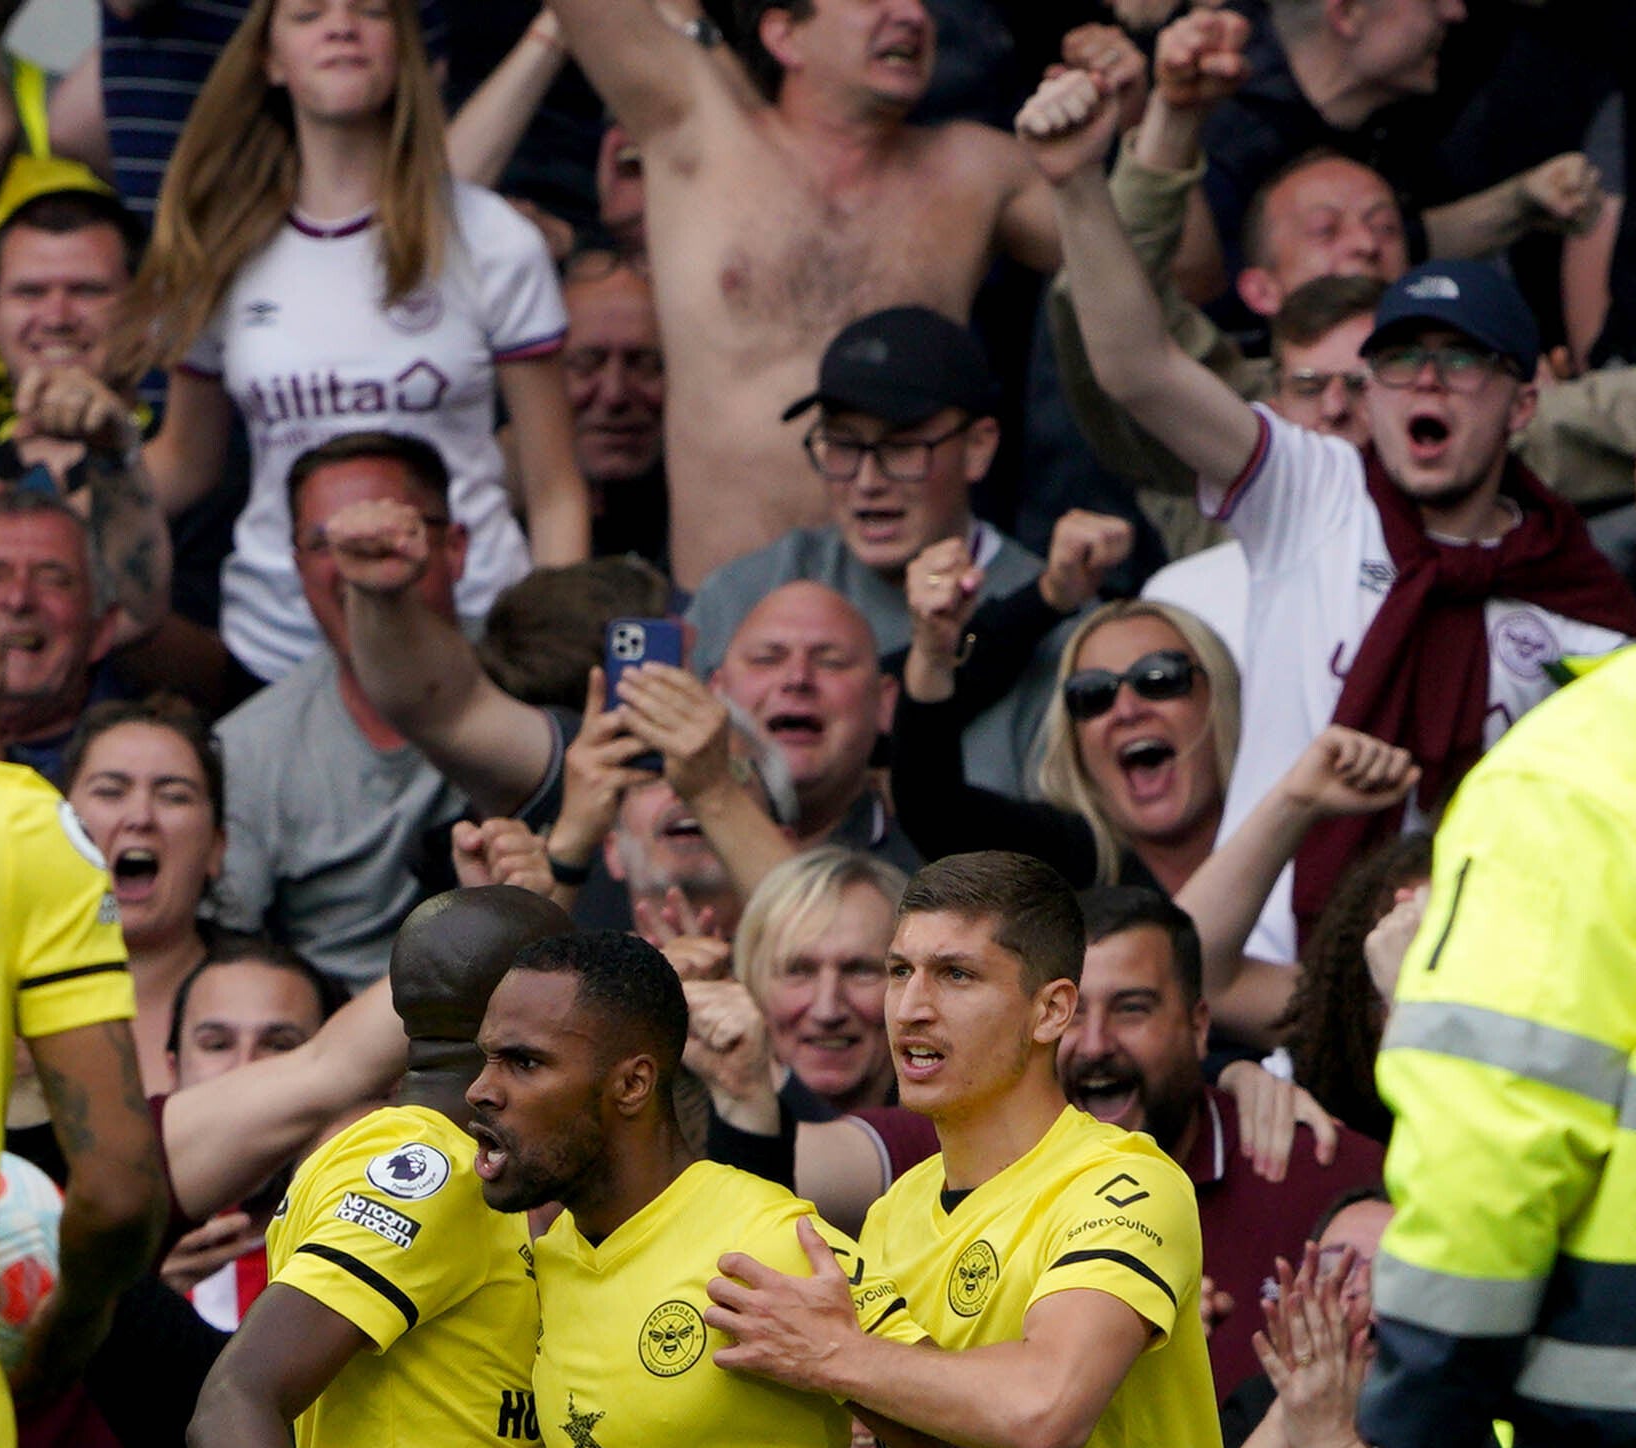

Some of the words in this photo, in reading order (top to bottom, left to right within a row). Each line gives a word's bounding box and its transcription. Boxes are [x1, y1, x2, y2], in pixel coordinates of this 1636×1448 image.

[247, 371, 386, 427] tilita
[342, 1191, 367, 1212] No
[365, 1201, 414, 1234] room
[358, 1212, 414, 1250] racism
[1067, 1215, 1164, 1247] SafetyCulture
